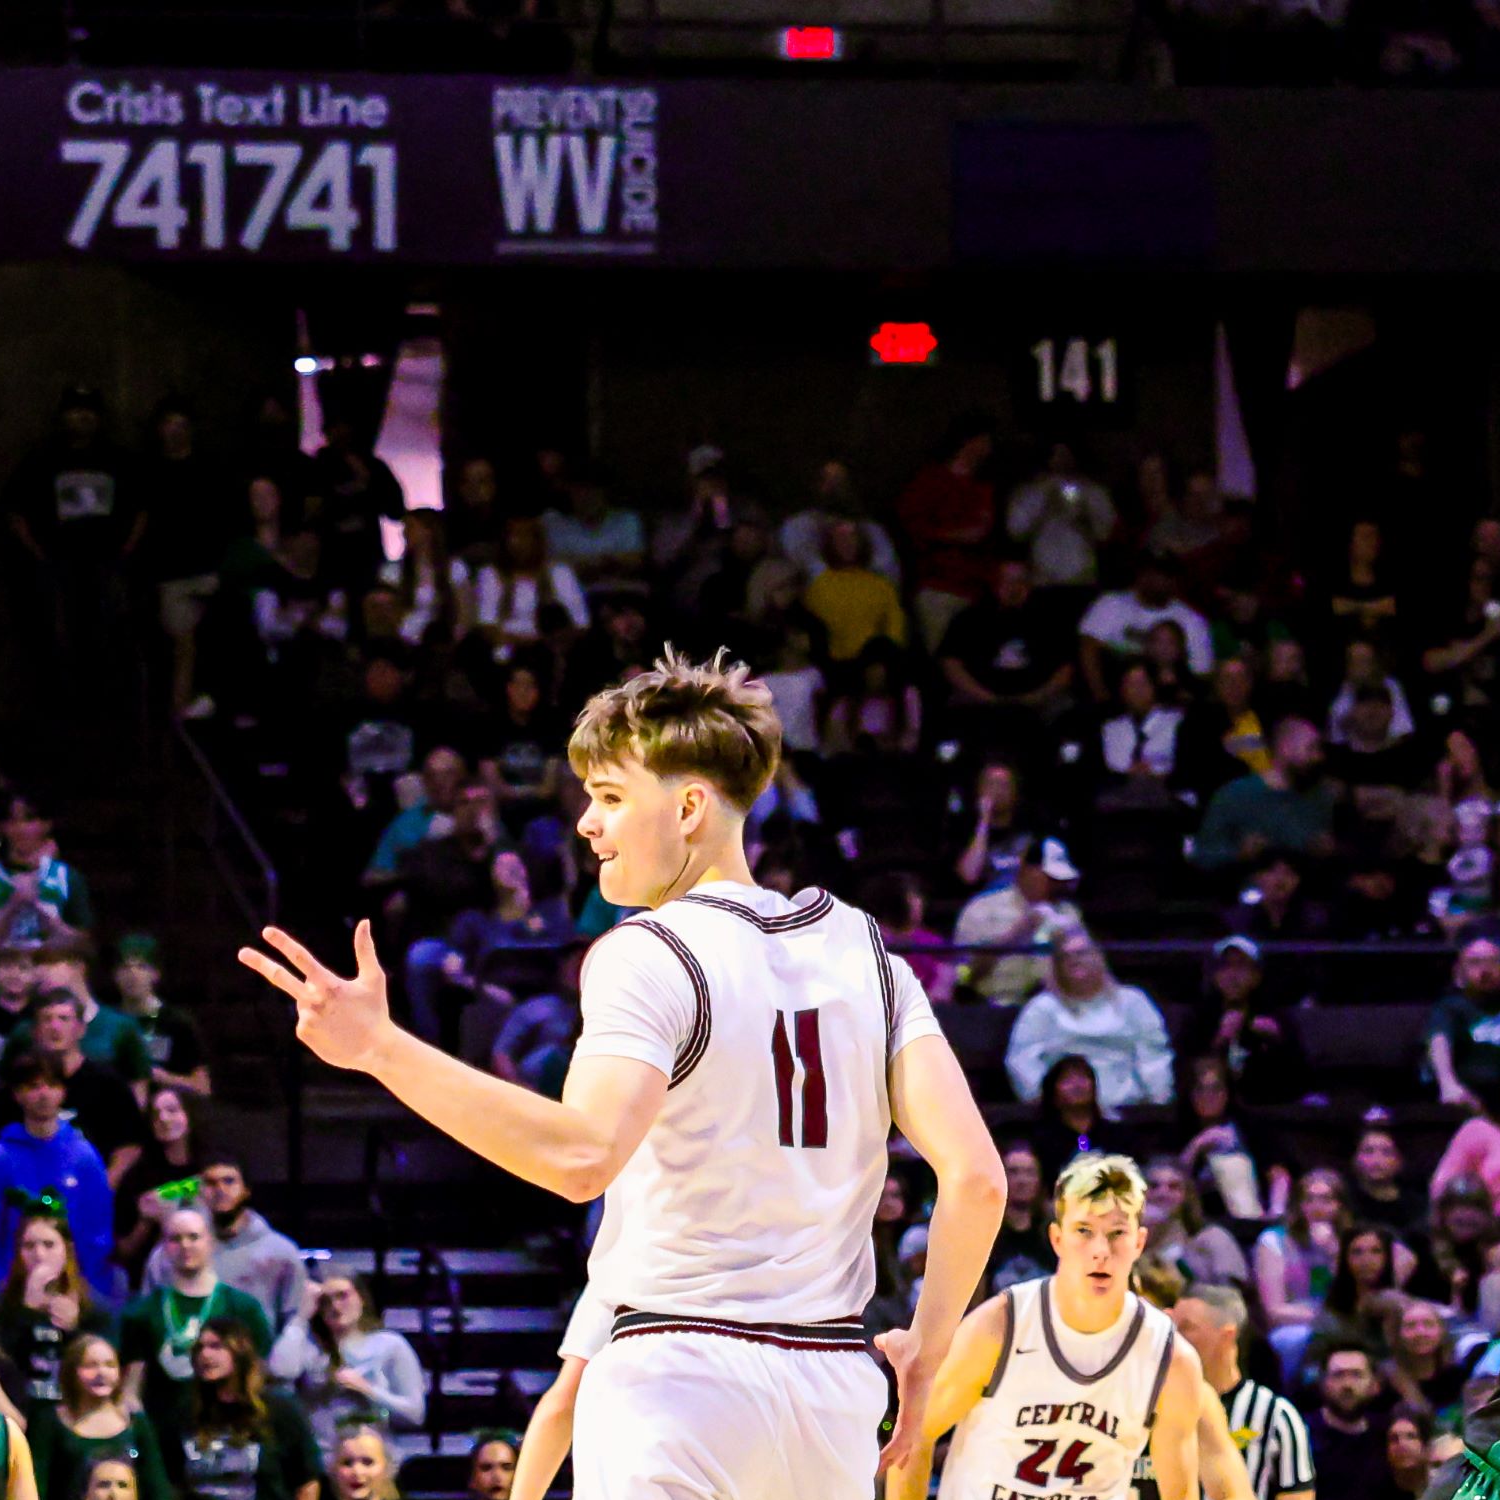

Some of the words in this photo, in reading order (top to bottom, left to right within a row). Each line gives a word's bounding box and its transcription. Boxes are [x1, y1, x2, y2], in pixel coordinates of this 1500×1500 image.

[67, 82, 185, 125] Crisis
[196, 82, 285, 126] Text
[299, 83, 389, 128] Line
[61, 141, 397, 249] 741741
[494, 134, 617, 232] WV
[1030, 336, 1119, 403] 141
[770, 1007, 828, 1149] 11
[1015, 1401, 1120, 1440] CENTRAL
[1014, 1438, 1096, 1488] 24
